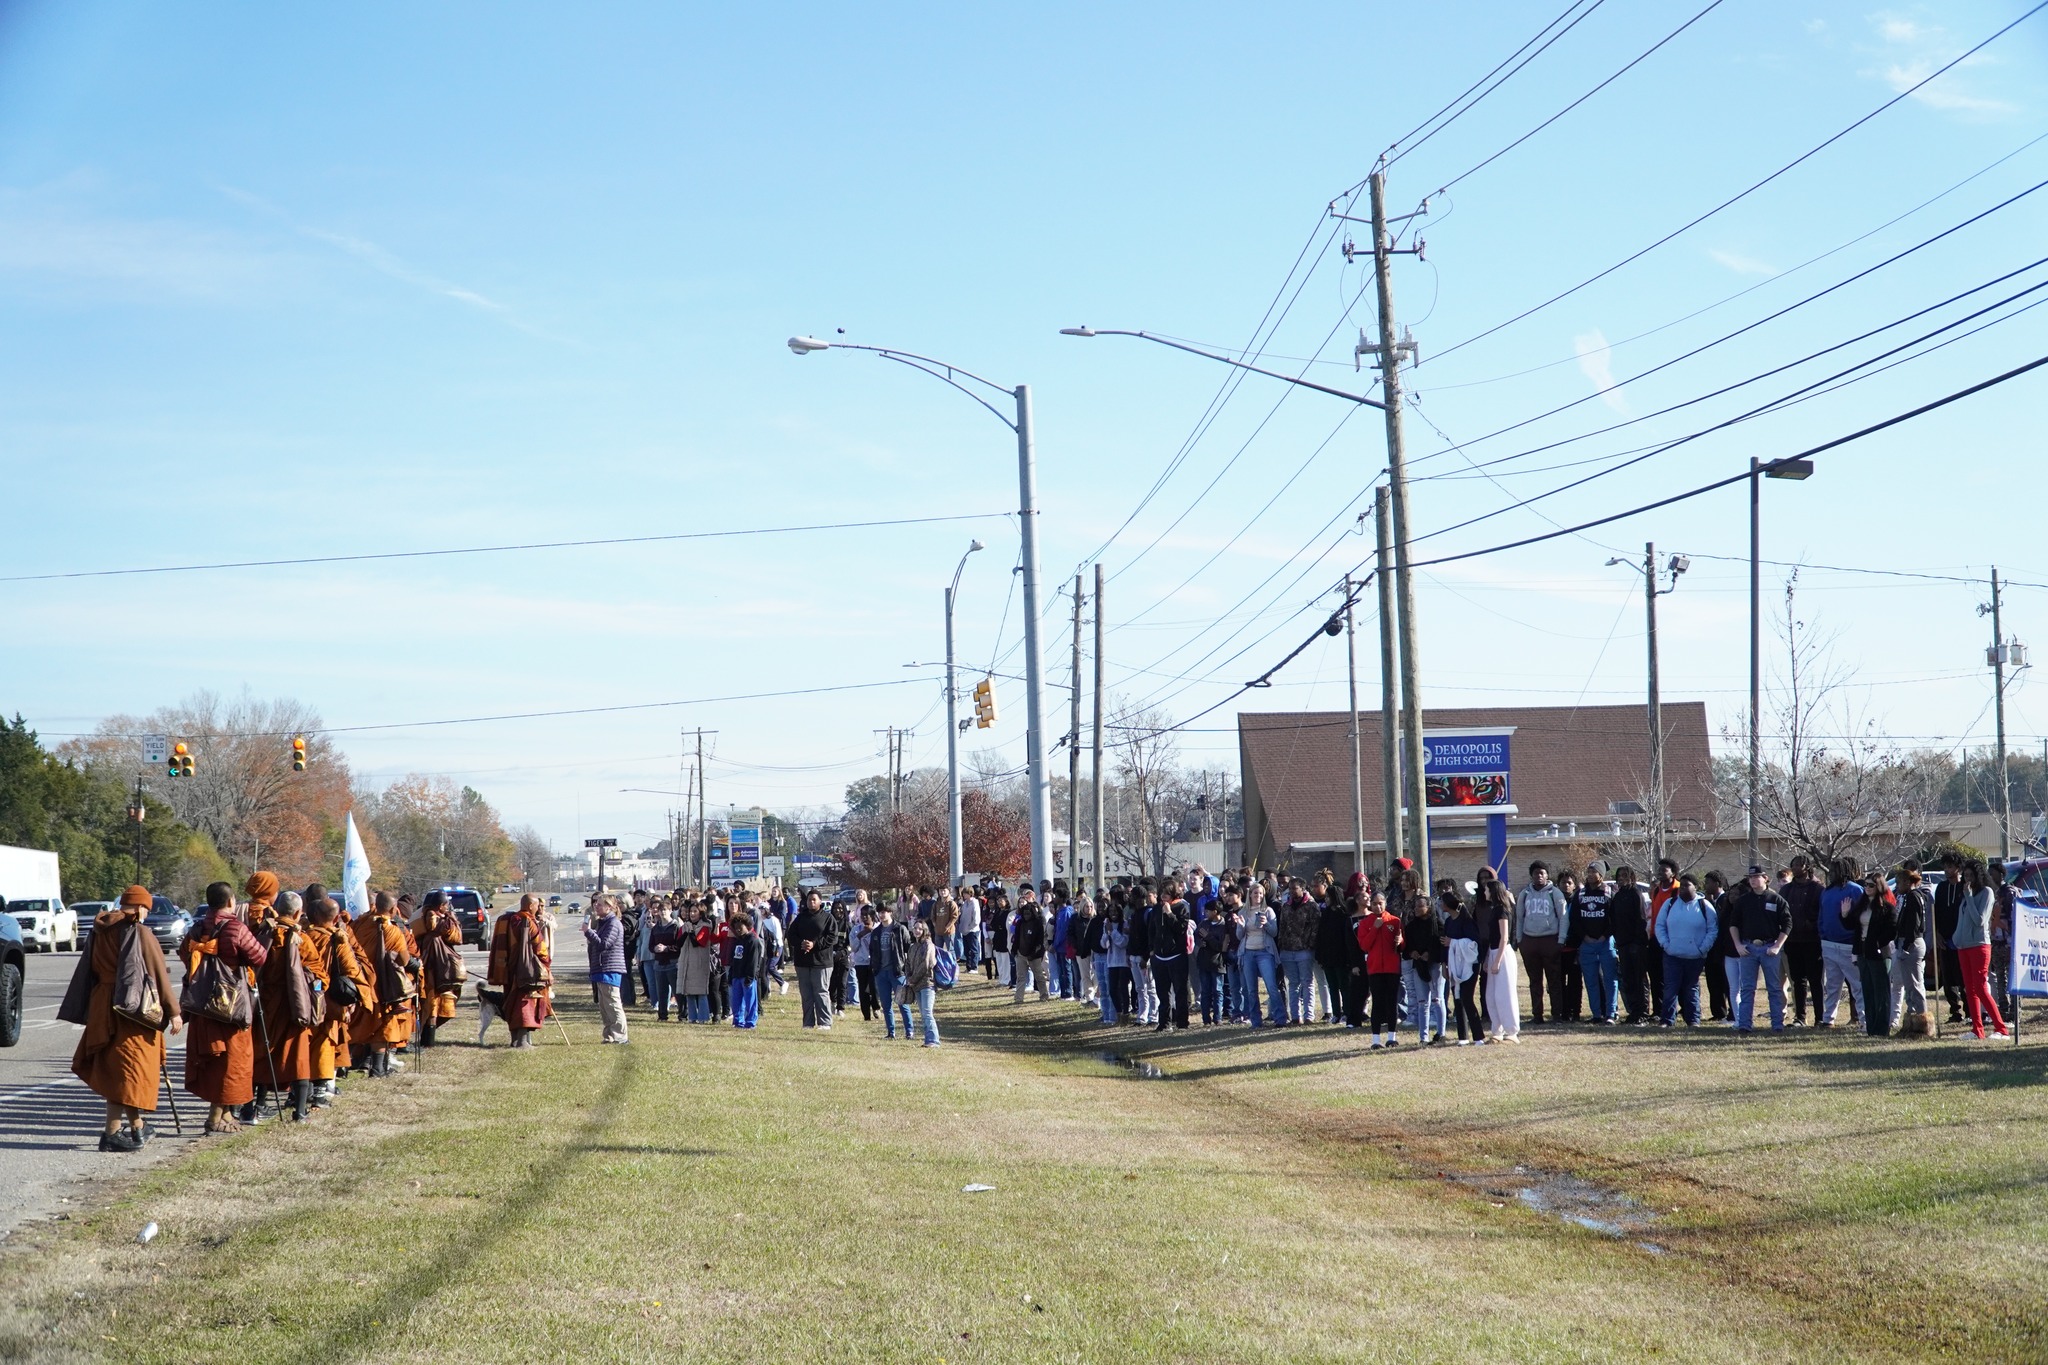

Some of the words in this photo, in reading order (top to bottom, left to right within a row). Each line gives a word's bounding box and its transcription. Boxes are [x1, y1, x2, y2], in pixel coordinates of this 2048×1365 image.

[1435, 743, 1502, 755] DEMOPOLIS
[1435, 756, 1461, 766] HIGH
[1462, 755, 1502, 765] SCHOOL
[1580, 909, 1606, 917] TIGERS
[2020, 953, 2048, 968] TRAD
